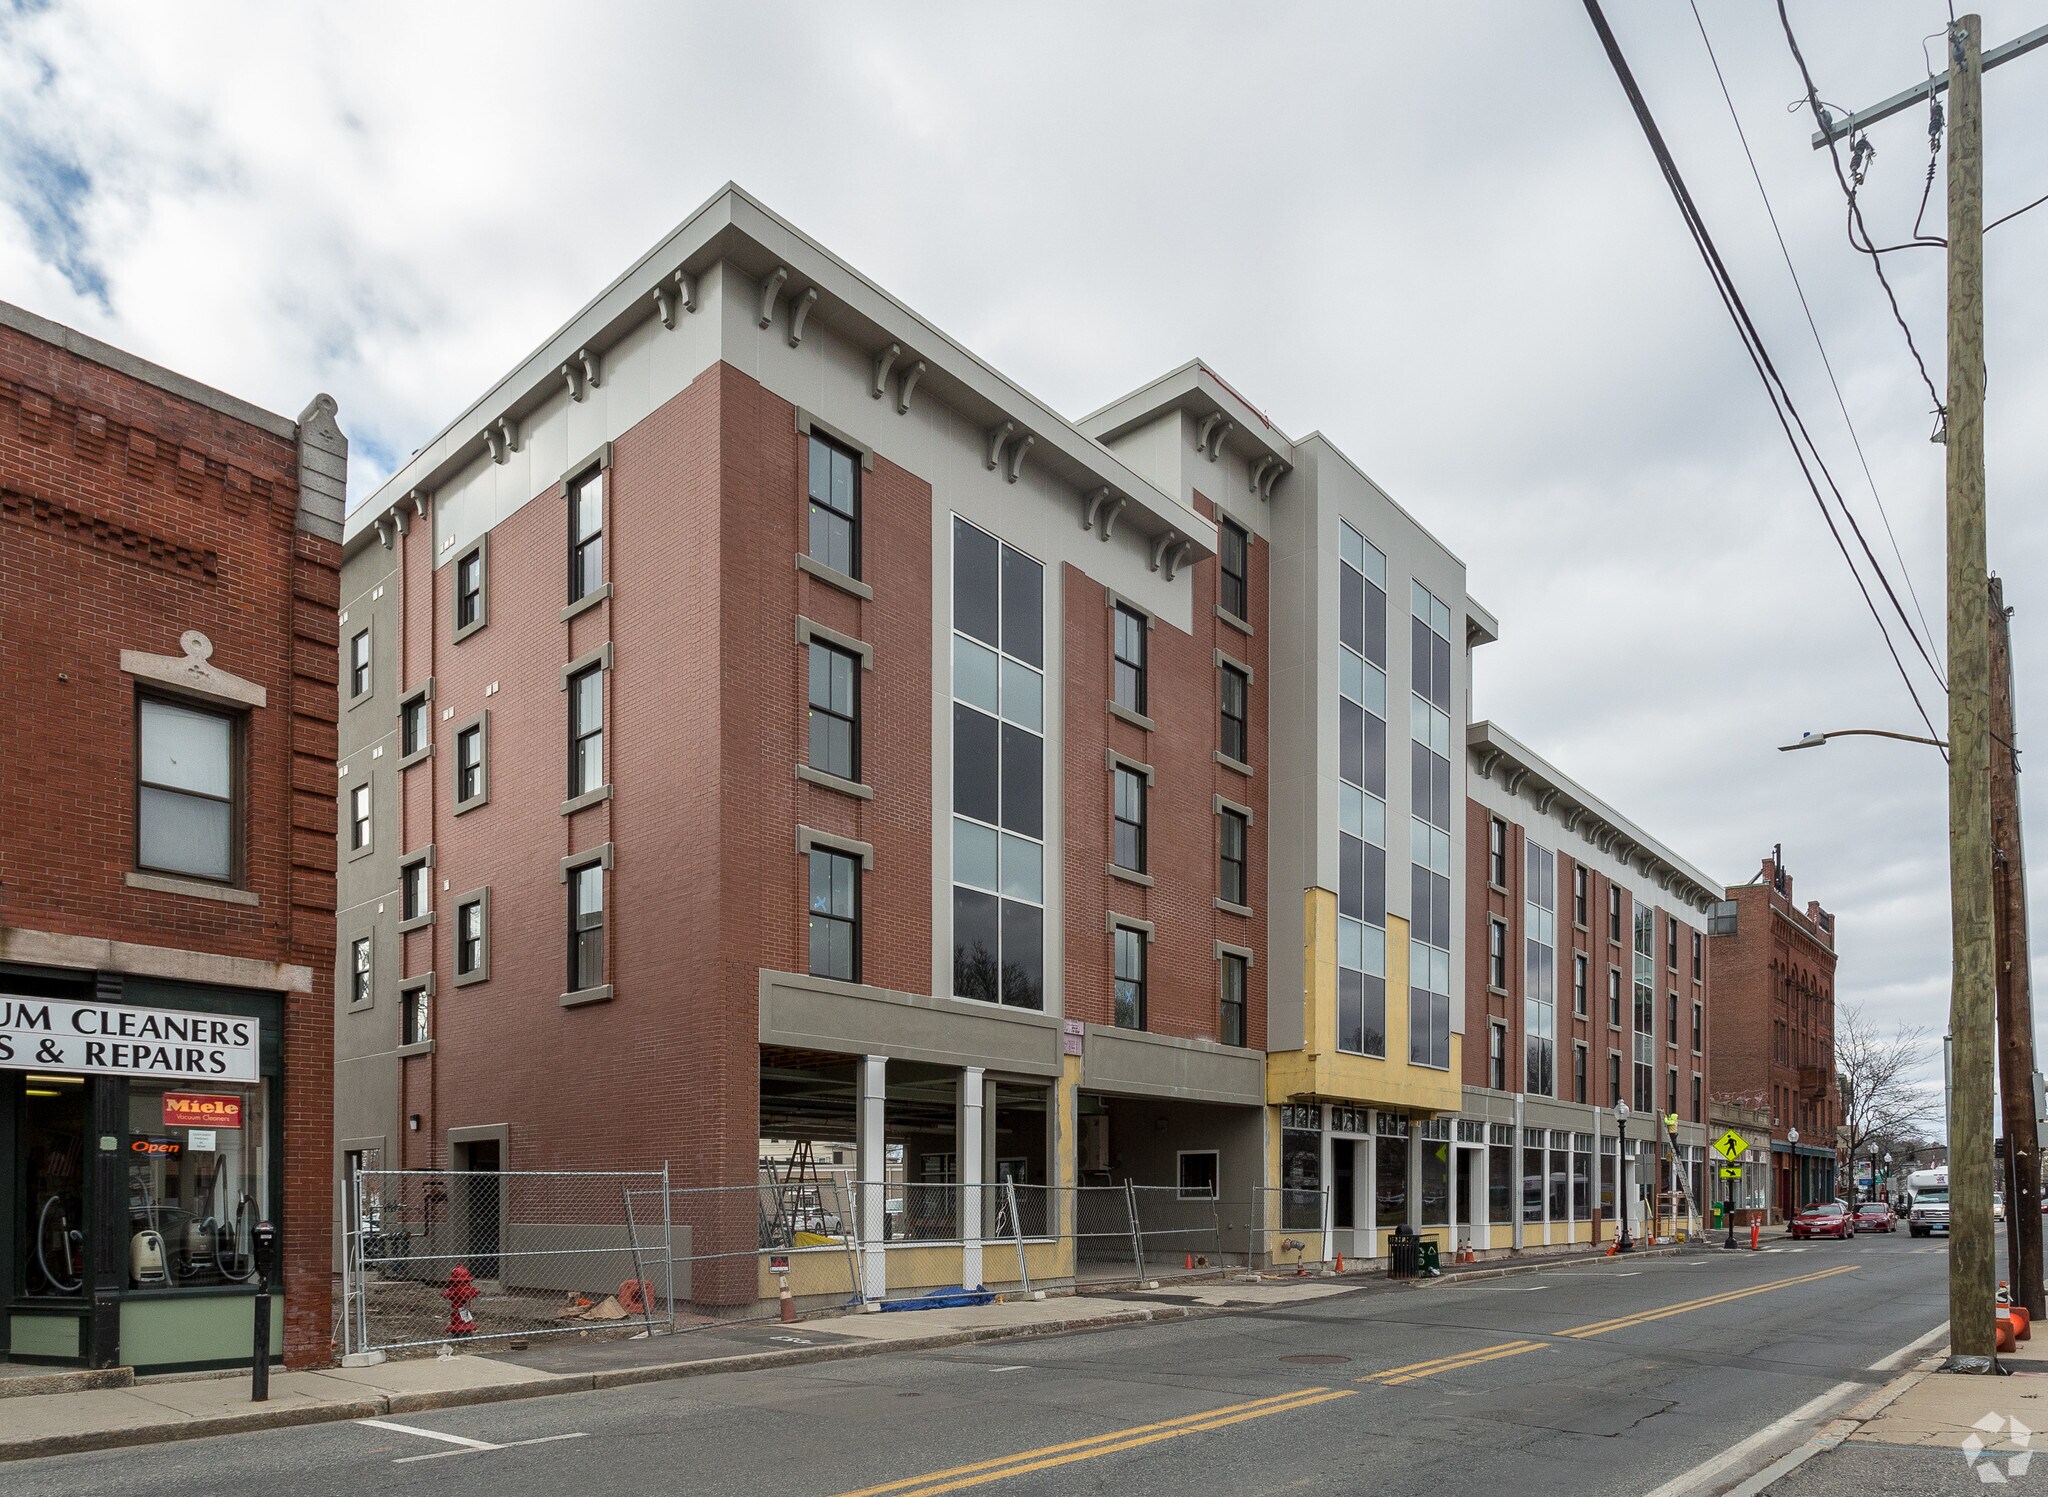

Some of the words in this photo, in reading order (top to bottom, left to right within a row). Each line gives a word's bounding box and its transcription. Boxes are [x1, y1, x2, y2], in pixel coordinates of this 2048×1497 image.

[71, 1008, 249, 1046] CLEANERS
[35, 1038, 64, 1064] &
[85, 1041, 226, 1074] REPAIRS
[166, 1098, 239, 1115] Miele
[176, 1113, 201, 1121] Vacuum
[202, 1114, 230, 1122] Cleaners
[131, 1141, 180, 1154] Open
